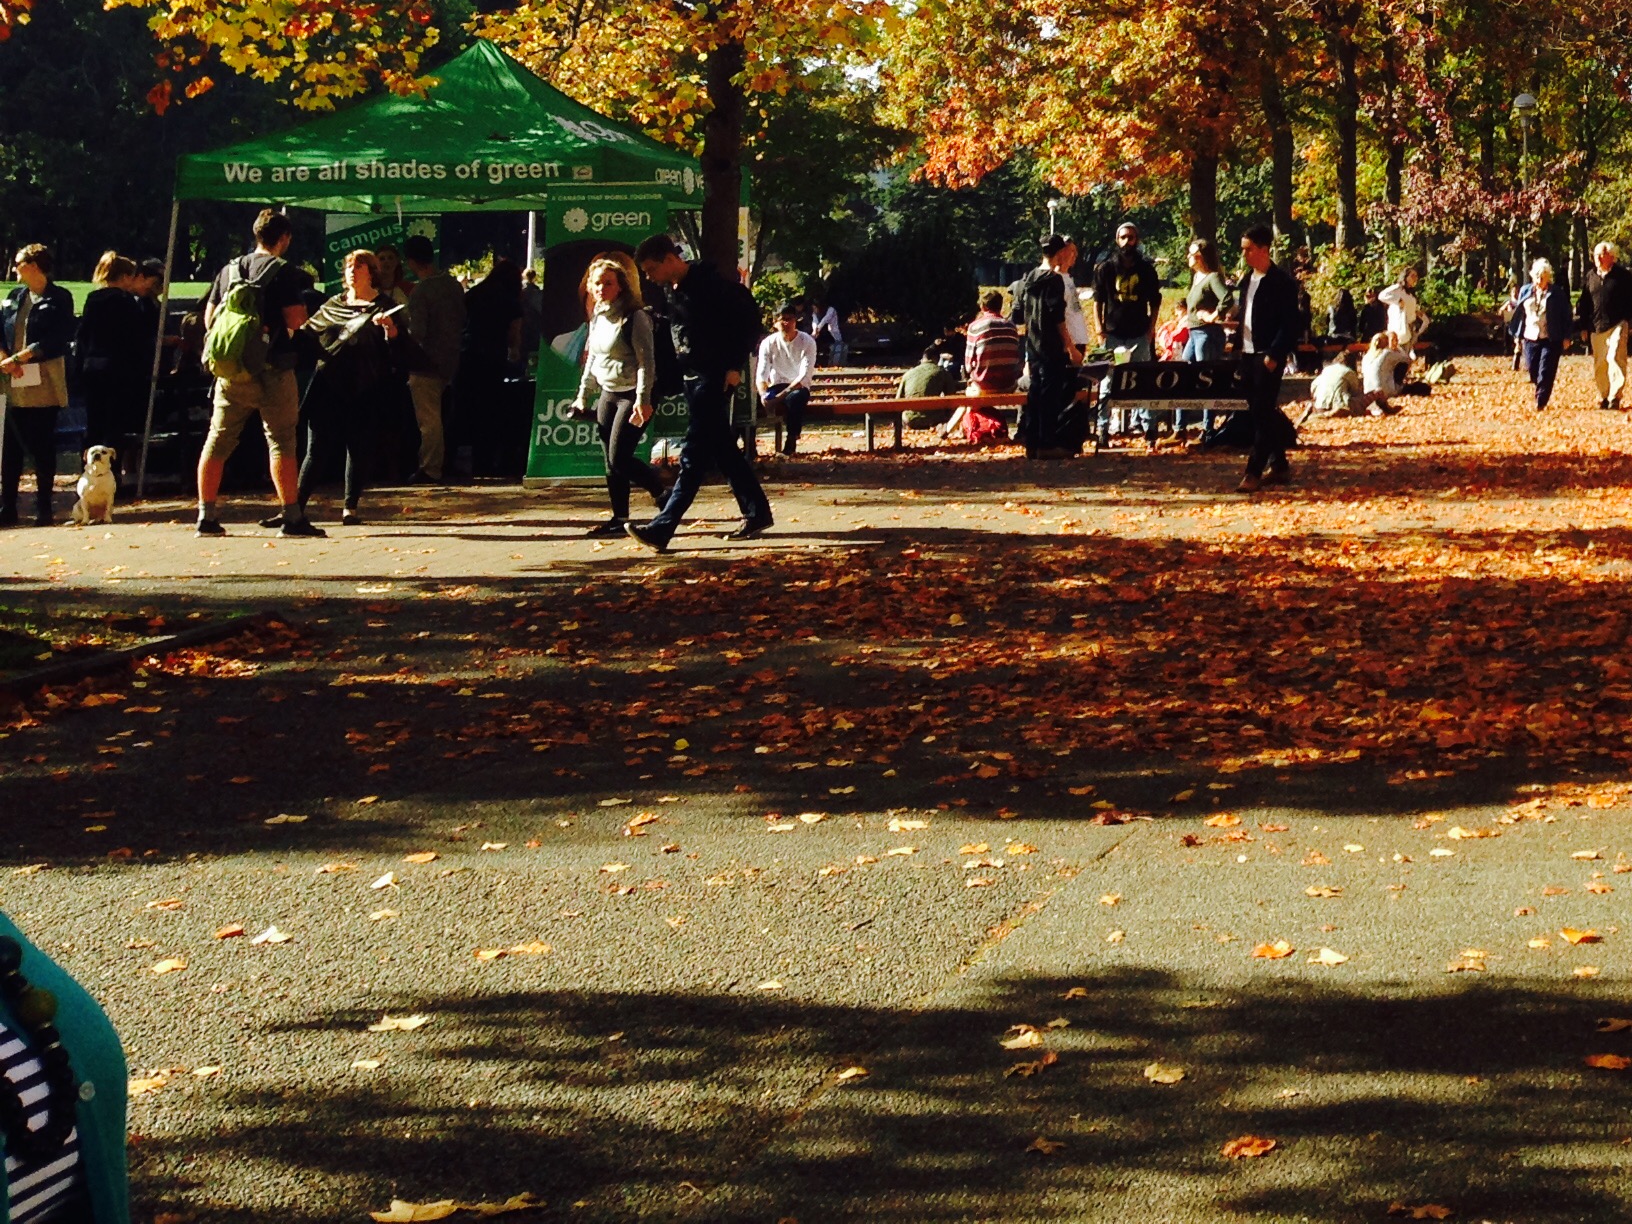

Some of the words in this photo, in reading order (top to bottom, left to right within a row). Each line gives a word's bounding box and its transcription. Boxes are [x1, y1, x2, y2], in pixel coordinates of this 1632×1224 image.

[223, 162, 263, 184] We
[271, 166, 310, 182] are
[318, 160, 347, 181] all
[355, 159, 447, 179] shades
[455, 159, 481, 179] of
[487, 161, 560, 185] green
[654, 167, 682, 186] green
[591, 211, 651, 232] green
[328, 222, 404, 253] campus
